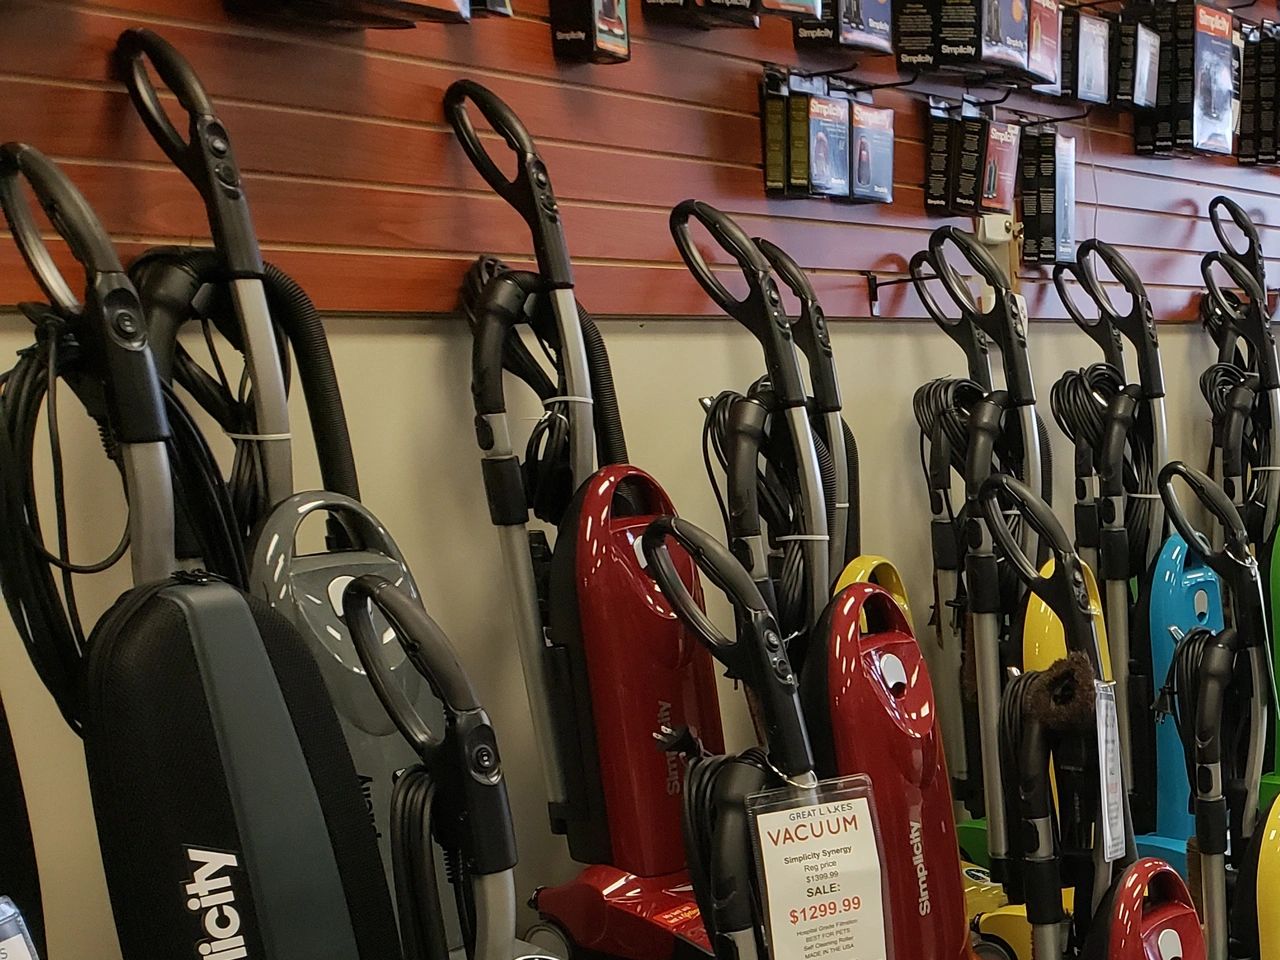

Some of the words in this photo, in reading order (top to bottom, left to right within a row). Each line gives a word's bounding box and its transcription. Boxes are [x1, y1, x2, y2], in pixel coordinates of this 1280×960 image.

[1199, 8, 1230, 35] Simplicity
[556, 31, 586, 40] Simplicity
[798, 28, 833, 39] Simplicity
[941, 44, 976, 56] Simplicity
[901, 54, 934, 64] Simplicity
[789, 808, 817, 821] GREAT
[767, 815, 858, 847] VACUUM
[784, 852, 820, 865] Simplicity
[822, 846, 852, 858] Synergy
[804, 864, 819, 872] Reg
[820, 860, 837, 870] price
[909, 819, 931, 917] Simplicity
[806, 870, 839, 884] $1399.99
[806, 882, 841, 897] SALE:
[789, 896, 861, 926] $1299.99
[806, 934, 820, 943] BEST
[822, 931, 835, 939] FOR
[835, 927, 850, 936] PETS
[805, 951, 822, 959] MADE
